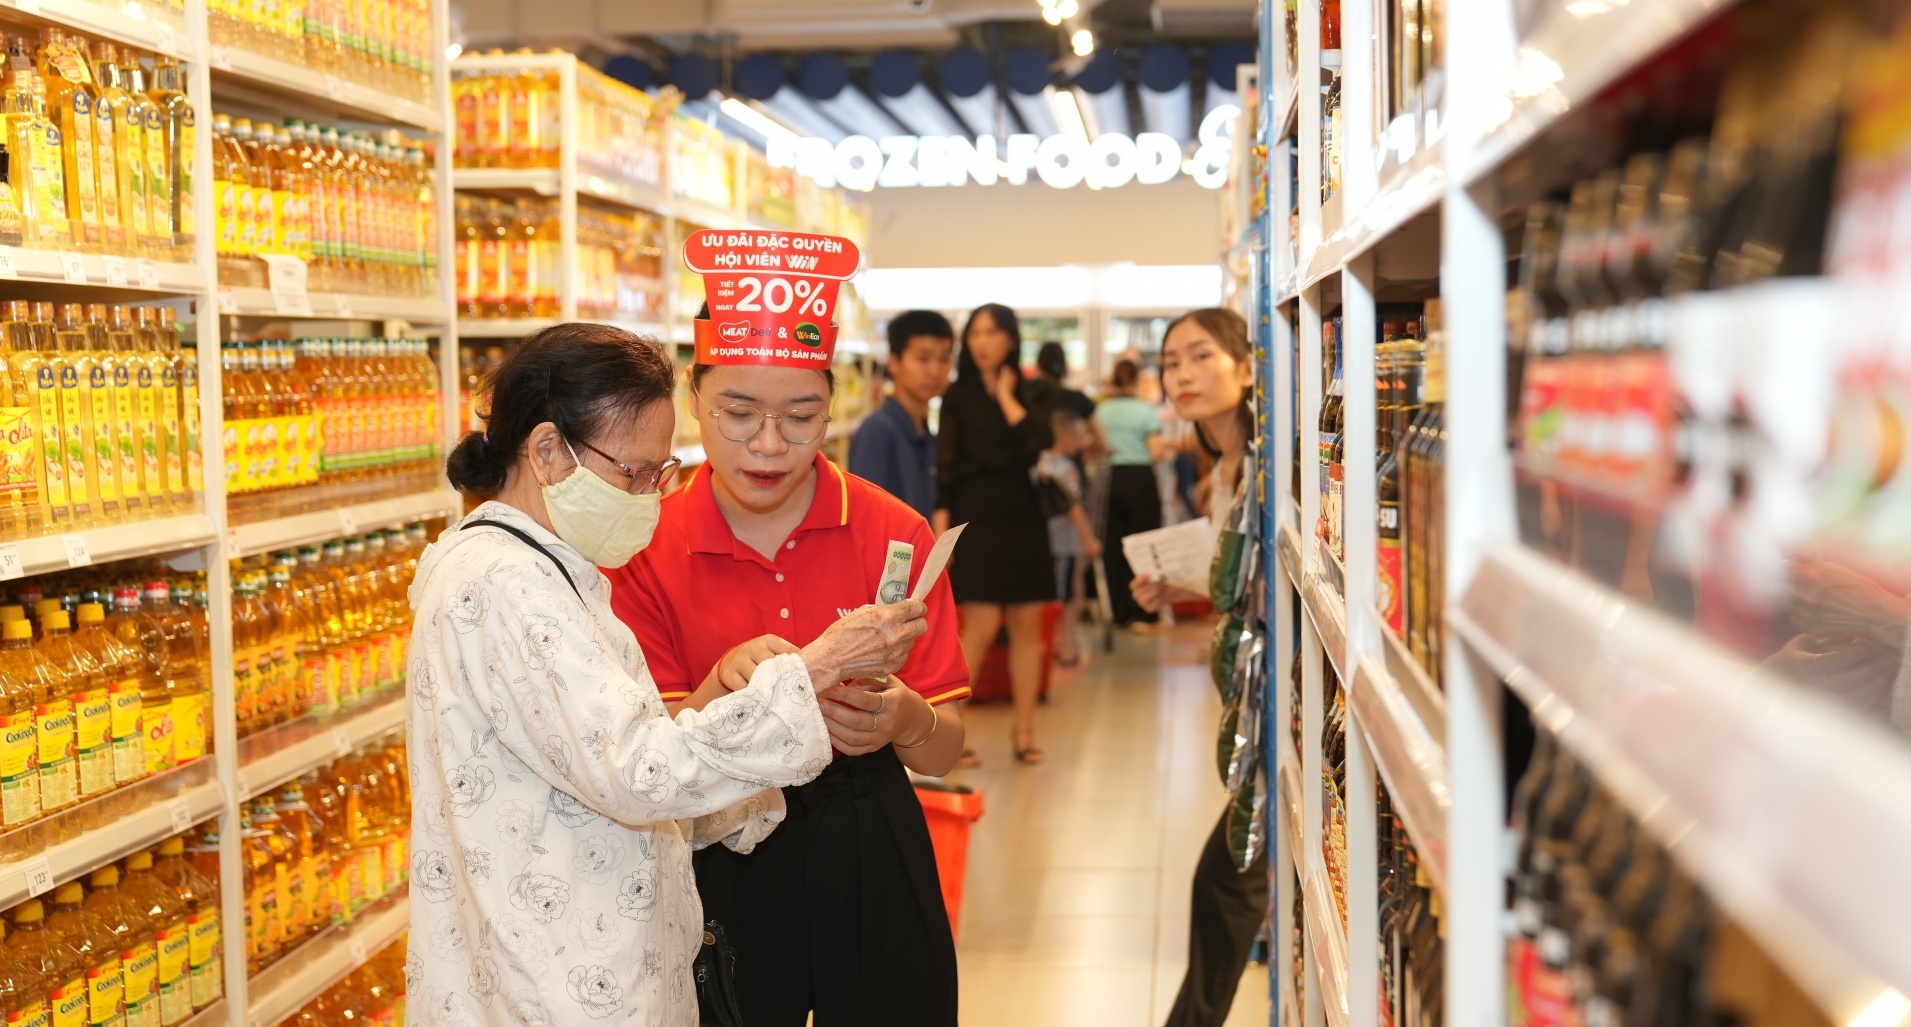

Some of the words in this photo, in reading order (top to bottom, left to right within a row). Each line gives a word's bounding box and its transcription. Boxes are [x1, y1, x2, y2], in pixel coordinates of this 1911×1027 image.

[1006, 132, 1182, 190] FOOD
[701, 233, 724, 247] ƯU
[727, 232, 753, 247] ĐÃI
[756, 233, 789, 250] ĐẶC
[792, 237, 843, 254] QUYỀN
[714, 250, 742, 268] HỘI
[745, 252, 781, 267] VIÊN
[720, 280, 735, 288] TIẾT
[717, 289, 735, 298] KIỆM
[735, 276, 828, 317] 20%
[722, 327, 748, 337] MEAT
[750, 327, 772, 337] Deli
[777, 326, 788, 339] &
[709, 346, 718, 356] ÁP
[720, 347, 744, 358] DỤNG
[746, 346, 773, 357] TOÀN
[775, 347, 790, 359] BỘ
[4, 554, 14, 566] 51
[34, 872, 47, 885] 123
